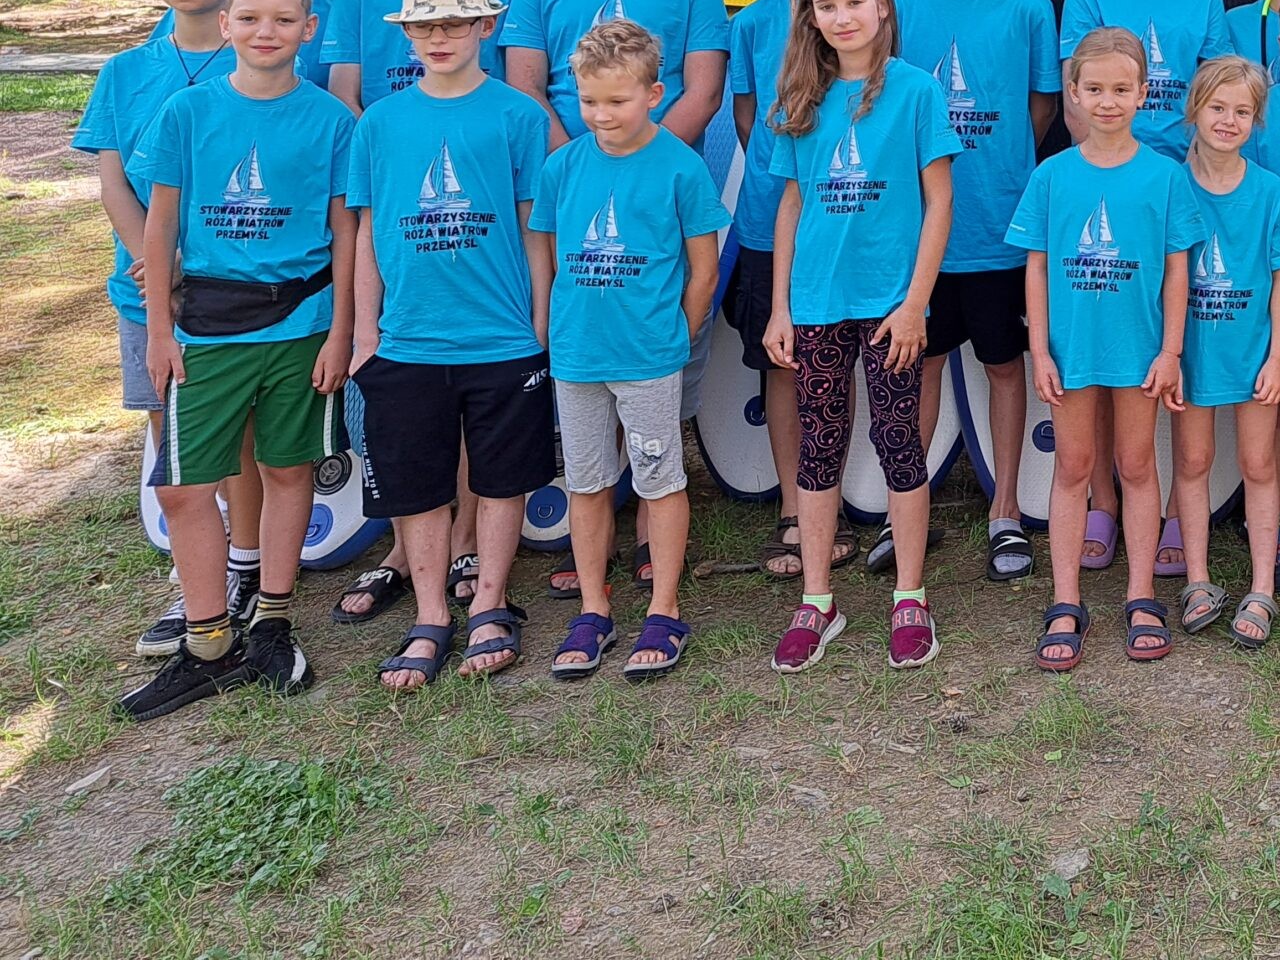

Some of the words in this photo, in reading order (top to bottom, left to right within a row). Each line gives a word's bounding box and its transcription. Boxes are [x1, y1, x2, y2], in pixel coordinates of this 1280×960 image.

[949, 111, 1000, 122] ZYSZENIE
[816, 180, 888, 192] STOWARZYSZENIE
[841, 190, 880, 203] WIATRÓW
[200, 205, 293, 216] STOWARZYSZENIE
[205, 215, 233, 228] RÓŻA
[237, 216, 284, 228] WIATRÓW
[398, 211, 497, 227] STOWARZYSZENIE
[215, 227, 270, 240] PRZEMYŚL
[404, 225, 433, 241] RÓŻA
[437, 224, 488, 238] WIATRÓW
[415, 237, 478, 254] PRZEMYŚL
[564, 252, 649, 266] STOWARZYSZENIE
[1062, 257, 1140, 270] STOWARZYSZENIE
[568, 263, 591, 276] RÓŻA
[593, 264, 641, 278] WIATRÓW
[1066, 268, 1088, 280] RÓŻA
[1090, 269, 1133, 281] WIATRÓW
[575, 276, 626, 288] PRZEMYŚL
[1072, 280, 1120, 293] PRZEMYŚL
[1206, 299, 1248, 310] WIATRÓW
